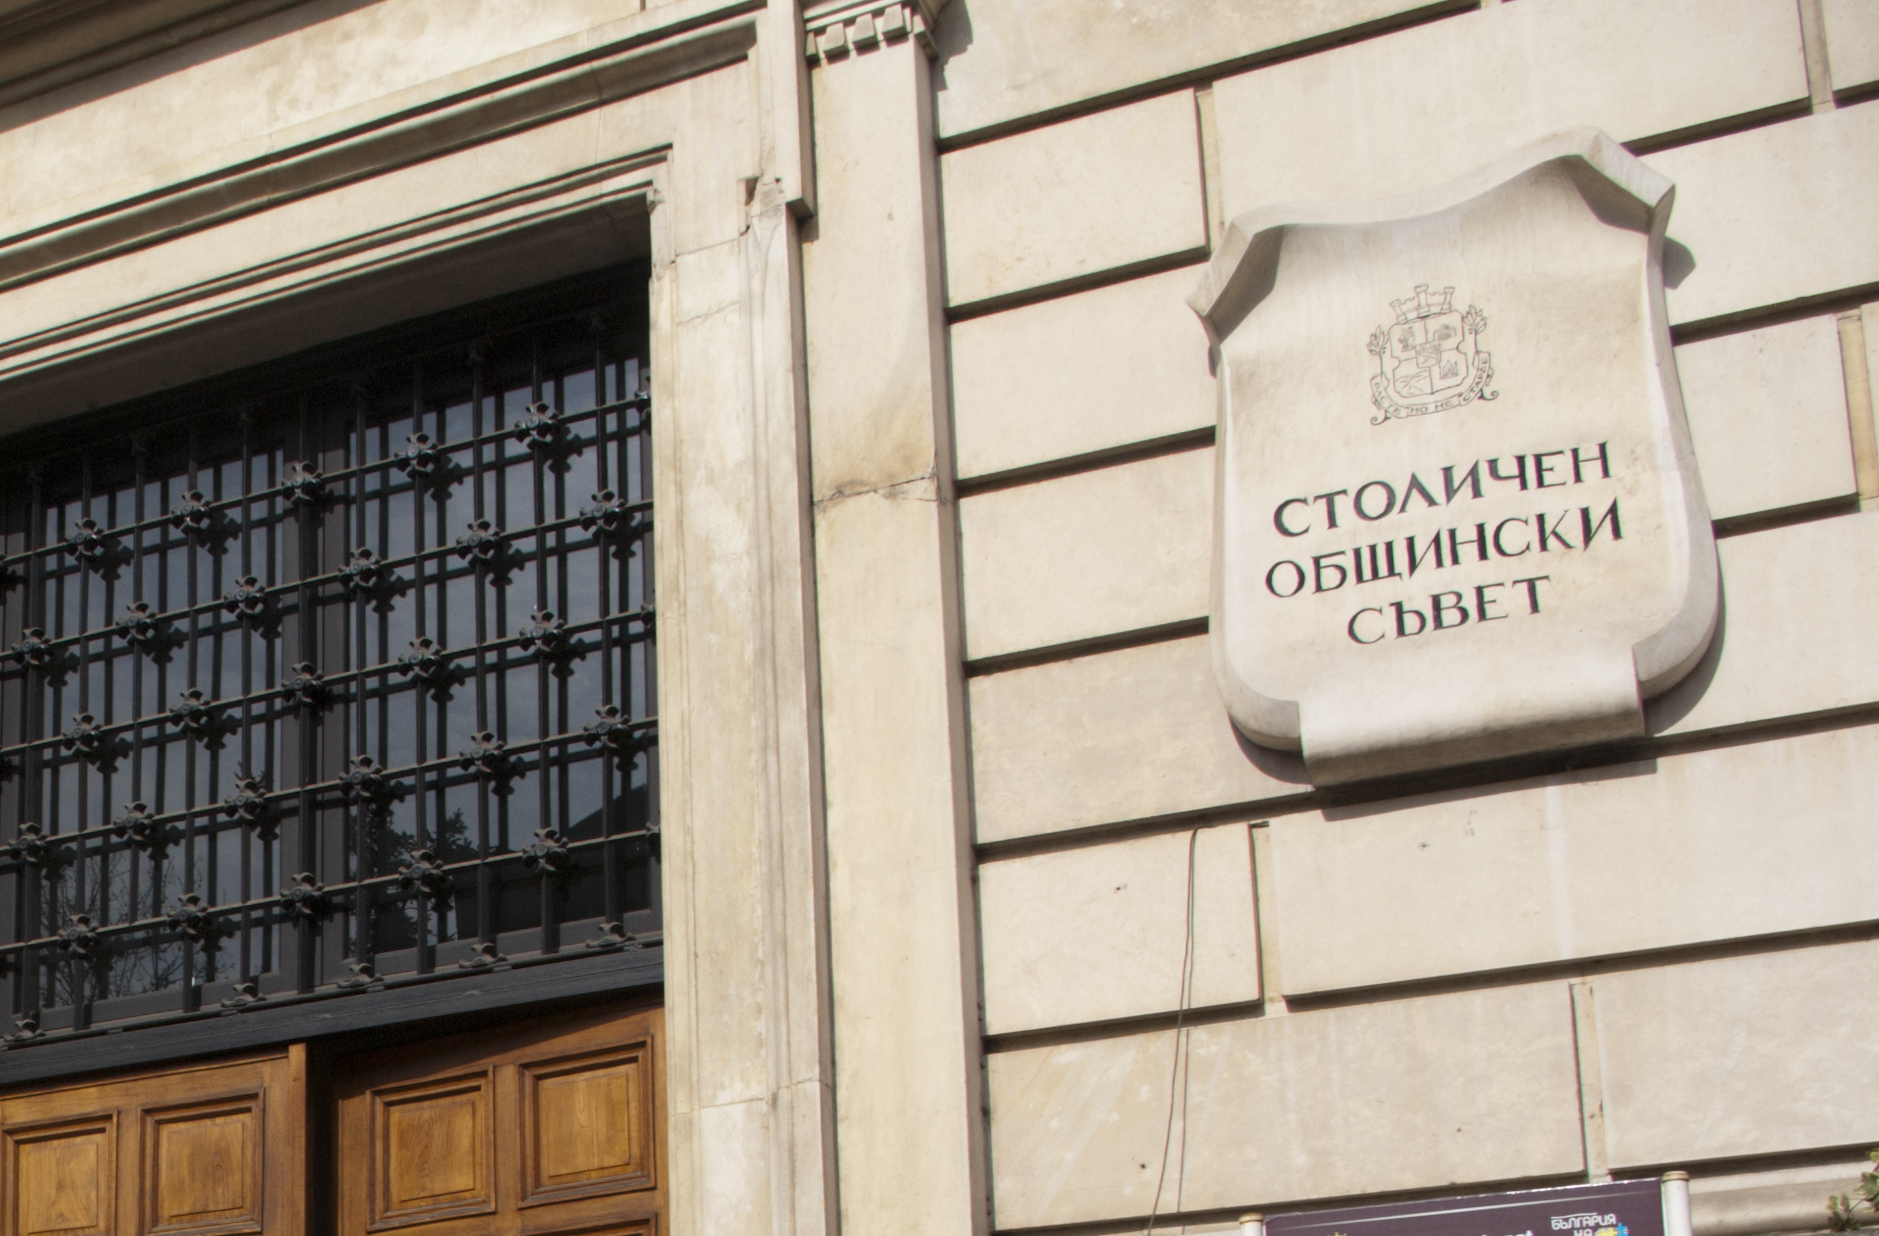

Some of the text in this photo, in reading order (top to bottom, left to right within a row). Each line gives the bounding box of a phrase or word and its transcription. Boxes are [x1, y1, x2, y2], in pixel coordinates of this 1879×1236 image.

[1273, 441, 1613, 538] СТОЛИЧЕН
[1265, 496, 1624, 598] ОБЩИНСКИ
[1347, 575, 1551, 645] СЪВЕТ
[1551, 1213, 1616, 1230] БЪЛГАРИЯ
